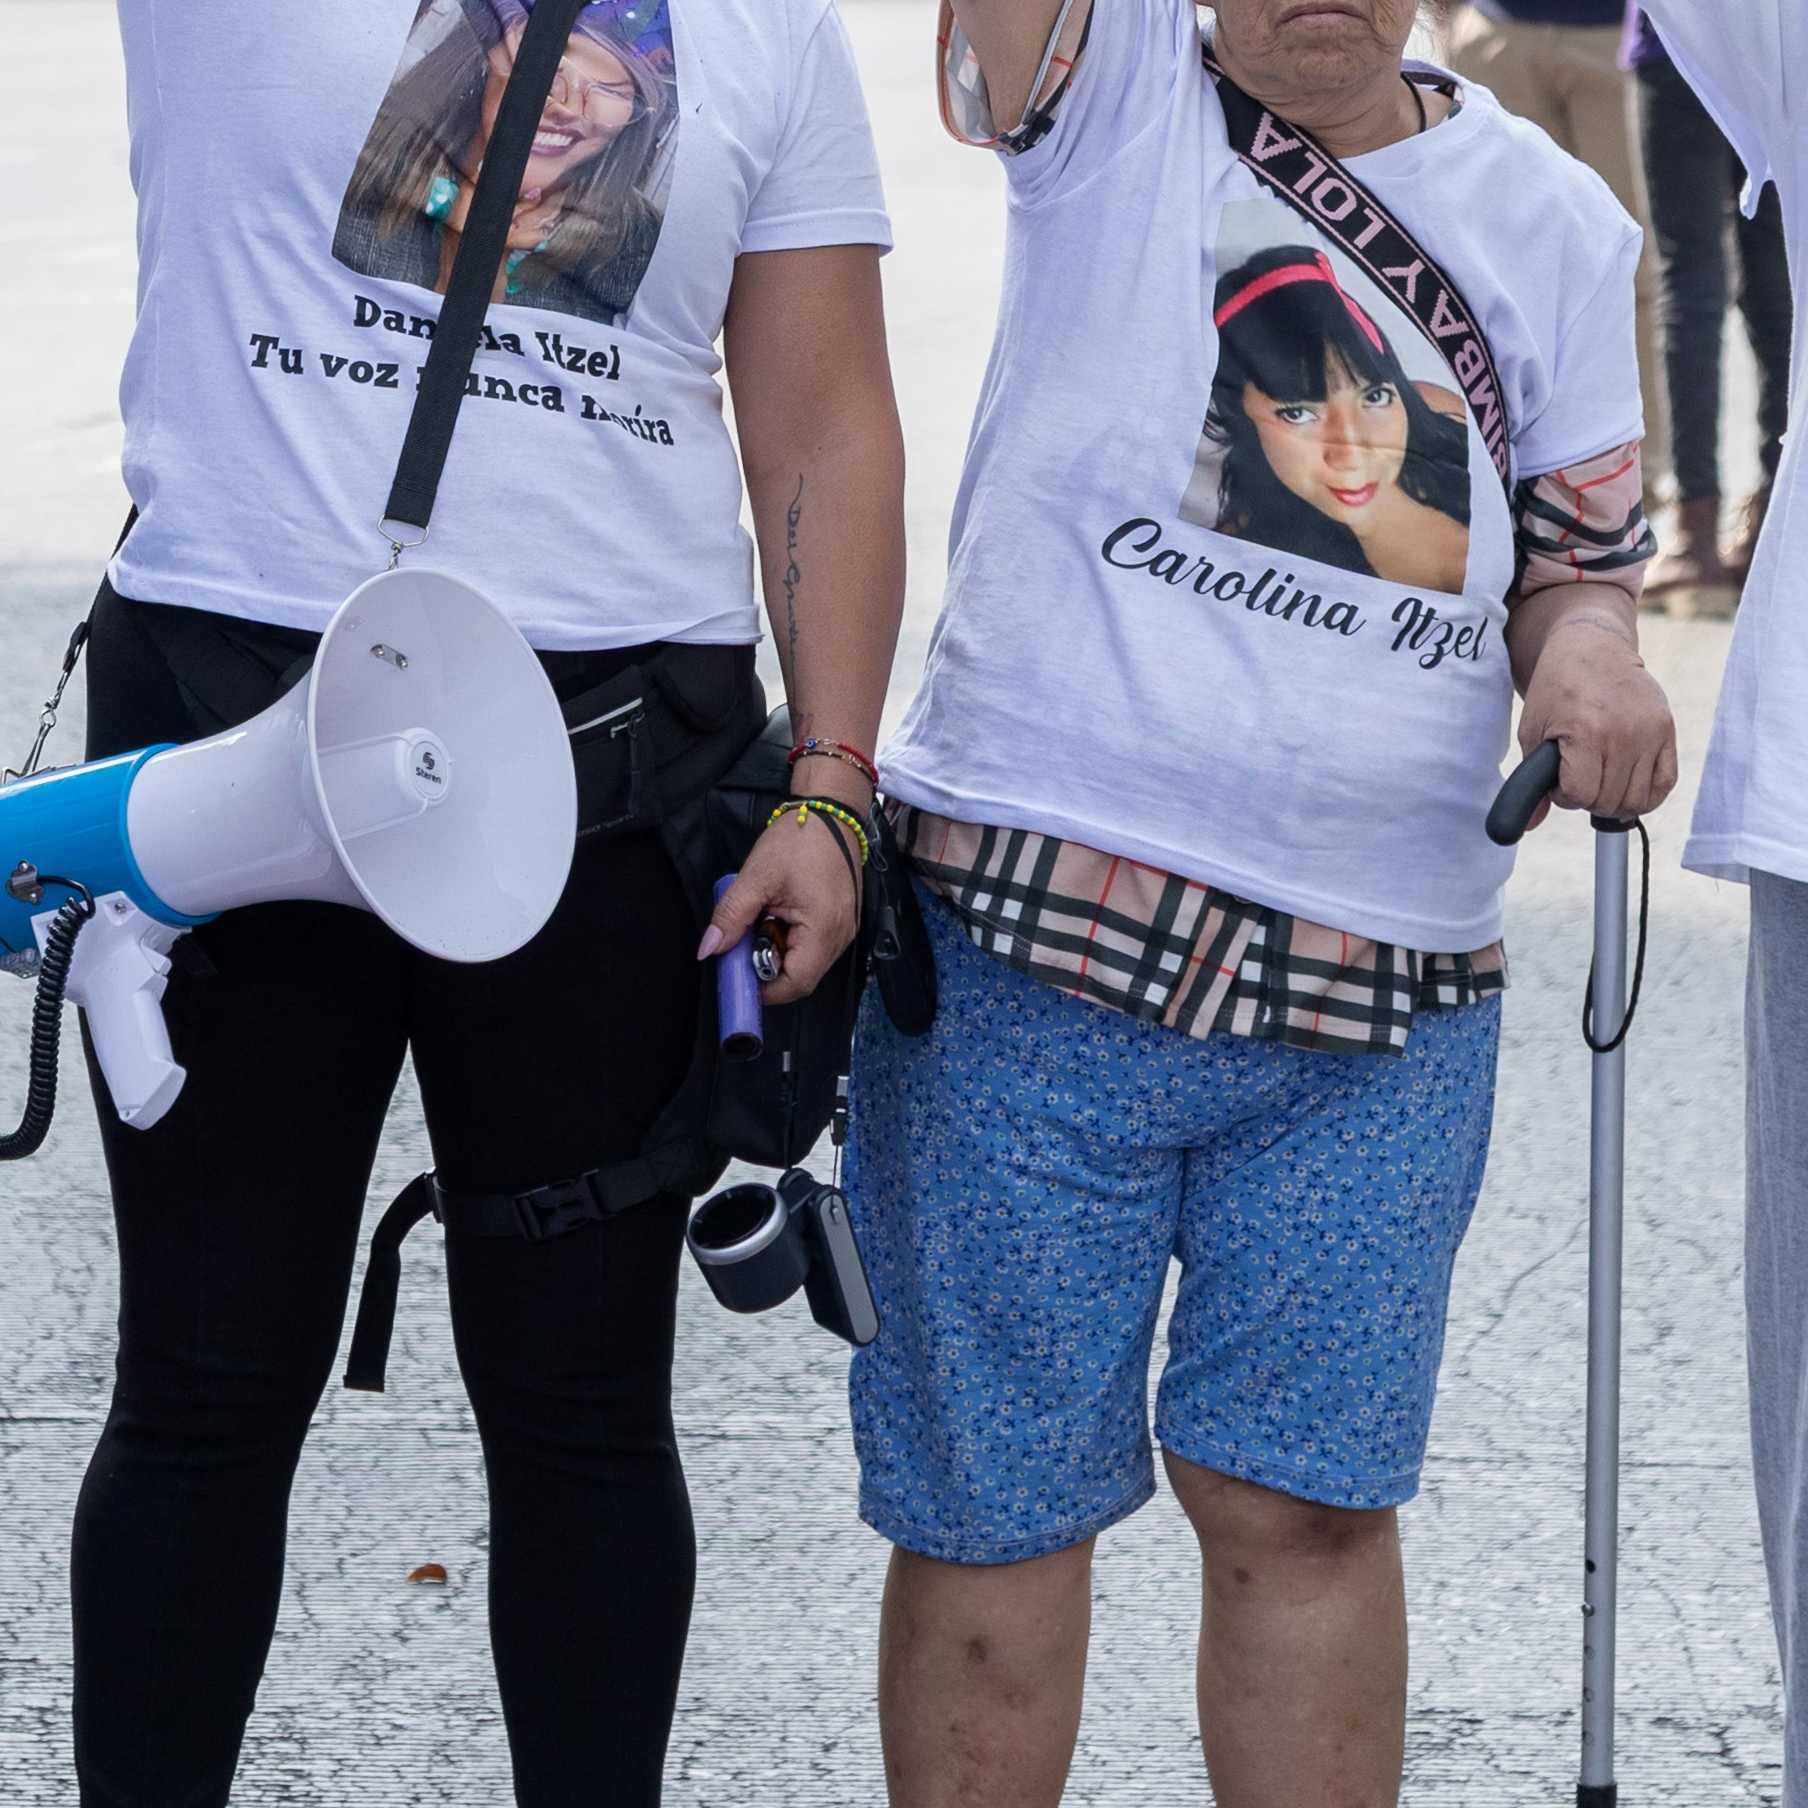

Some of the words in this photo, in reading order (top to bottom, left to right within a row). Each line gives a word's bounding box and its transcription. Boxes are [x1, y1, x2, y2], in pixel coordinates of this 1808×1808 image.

[1250, 111, 1387, 250] LOLA
[1382, 258, 1426, 304] Y
[248, 334, 304, 375] Tu
[319, 352, 399, 389] voz
[416, 365, 566, 414] unca
[353, 294, 526, 357] Danla
[534, 331, 621, 381] Itzel
[1429, 289, 1509, 479] BIMBA
[1101, 517, 1368, 637] Carolina
[1390, 595, 1489, 670] Itzel
[415, 766, 442, 785] Steren
